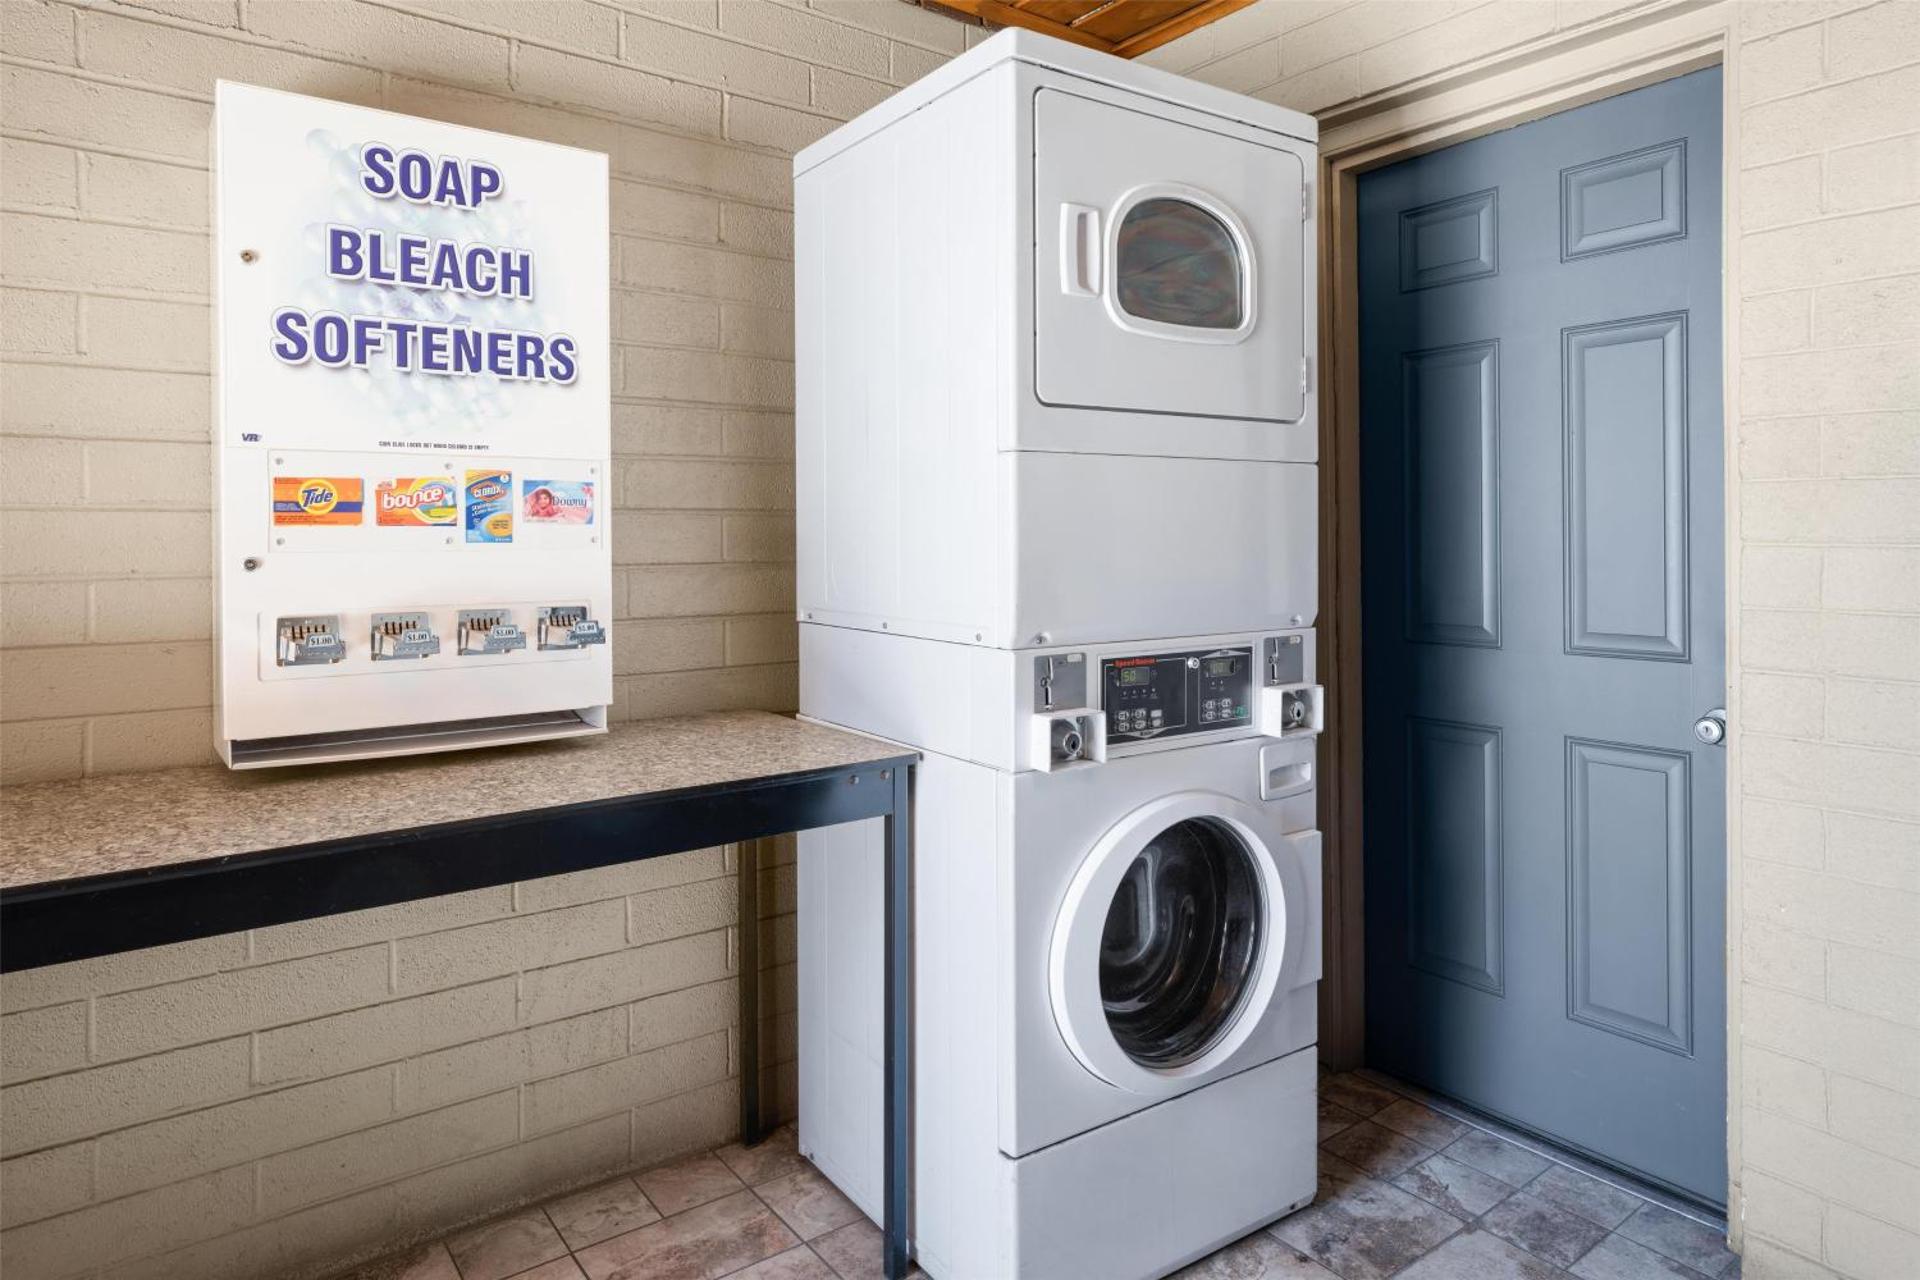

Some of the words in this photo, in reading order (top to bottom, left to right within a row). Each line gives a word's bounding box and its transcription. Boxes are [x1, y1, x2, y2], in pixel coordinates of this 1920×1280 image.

[362, 145, 501, 208] SOAP
[328, 227, 532, 297] BLEACH
[273, 311, 577, 382] SOFTENERS
[301, 487, 334, 508] Tide
[382, 486, 444, 511] bounce
[551, 495, 588, 508] Downy
[310, 636, 333, 646] $1.00
[406, 633, 428, 641] $1.00
